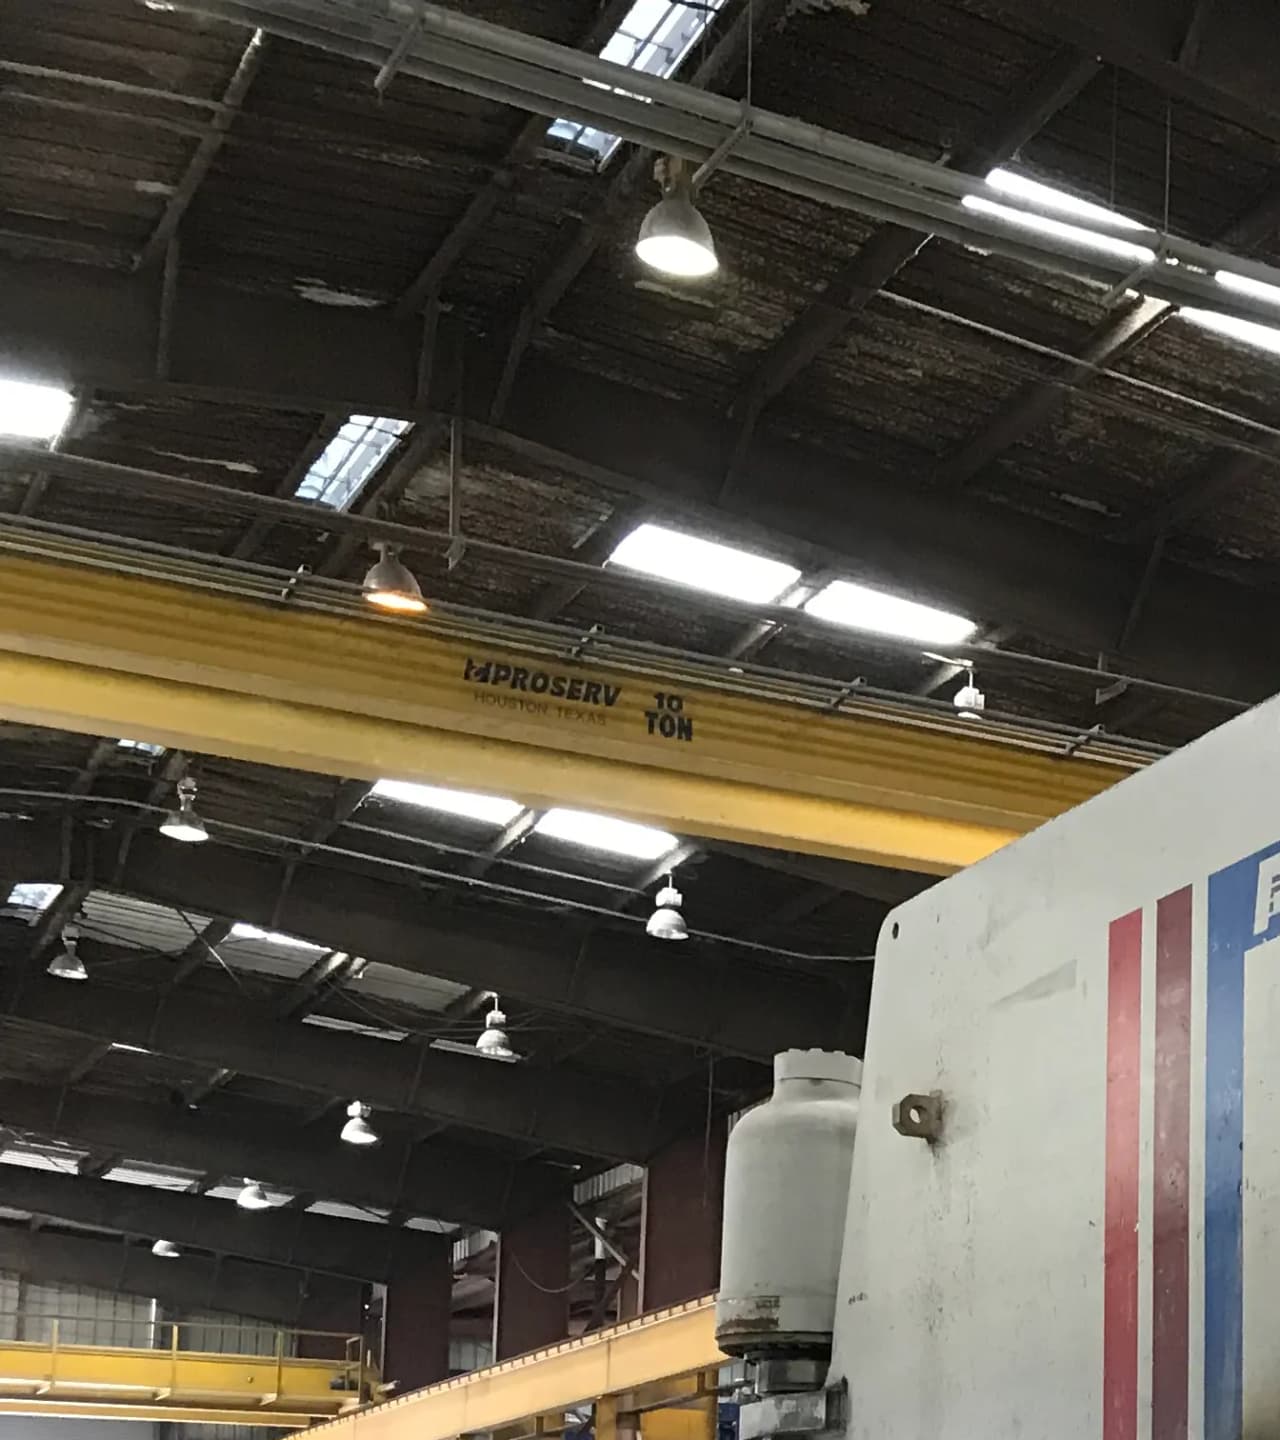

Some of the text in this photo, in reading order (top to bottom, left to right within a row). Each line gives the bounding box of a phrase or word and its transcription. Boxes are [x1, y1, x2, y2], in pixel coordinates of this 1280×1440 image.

[654, 692, 683, 713] 10
[556, 706, 607, 727] TEXAS
[644, 710, 694, 742] TON
